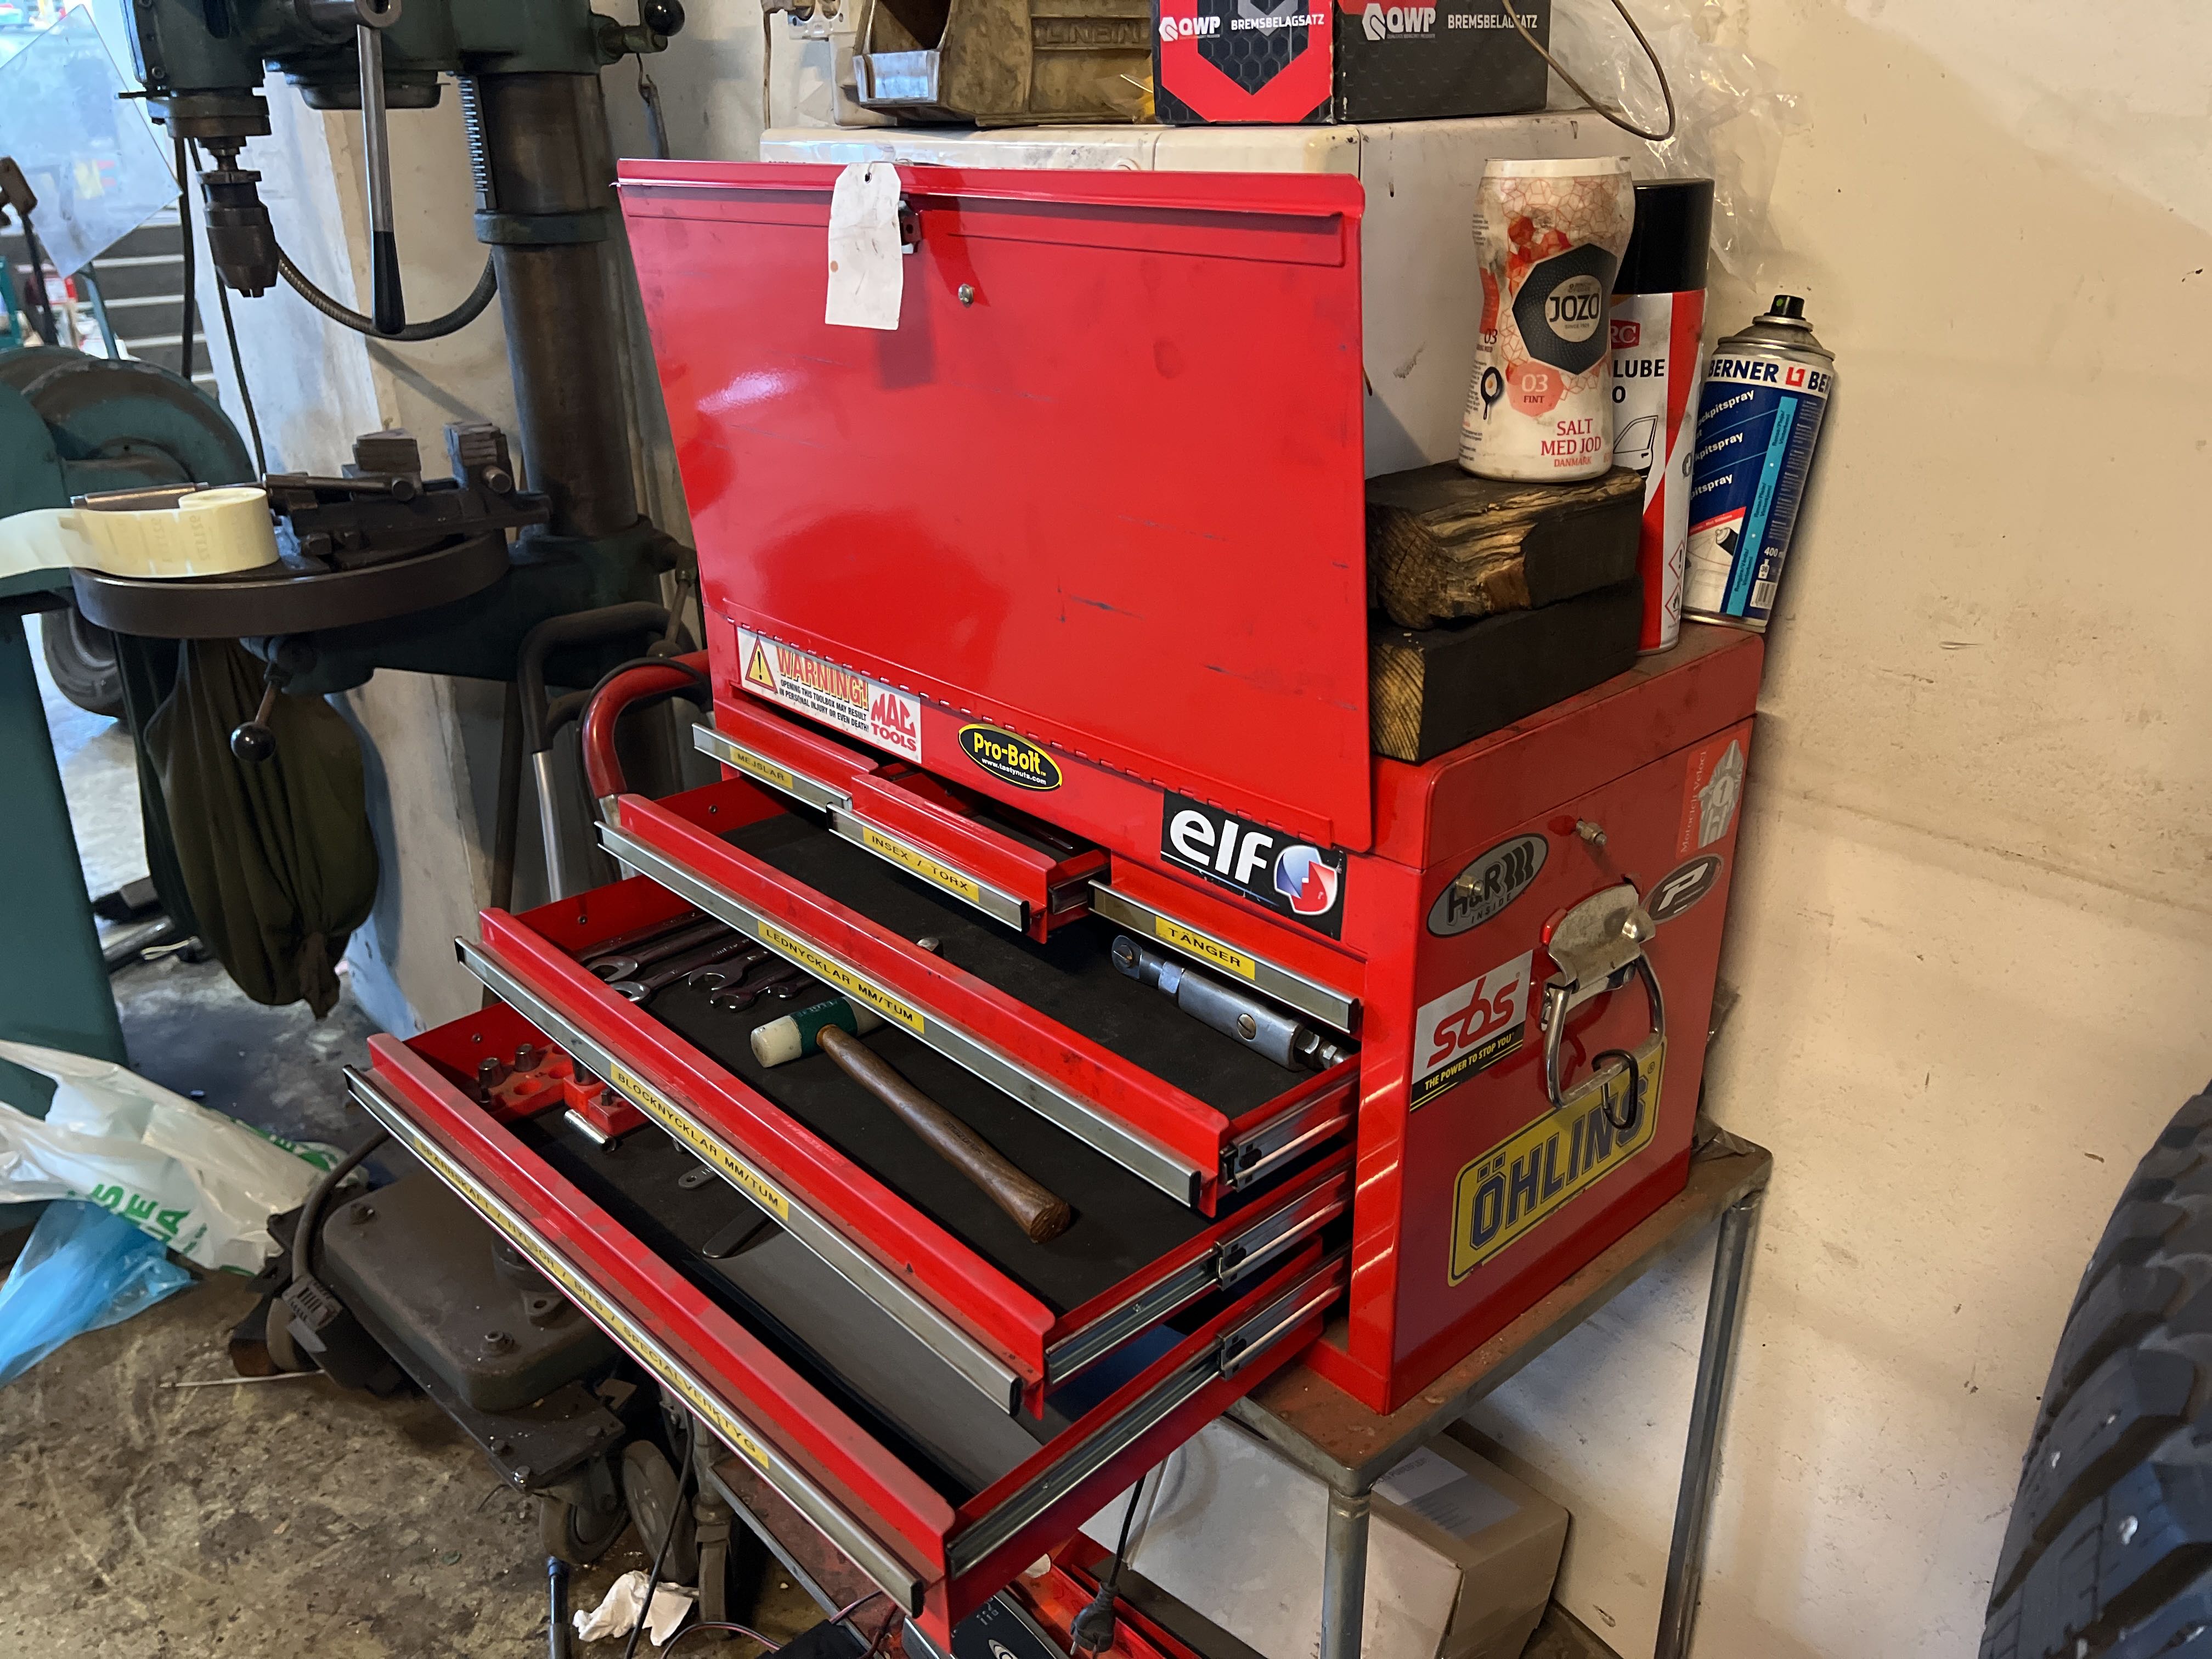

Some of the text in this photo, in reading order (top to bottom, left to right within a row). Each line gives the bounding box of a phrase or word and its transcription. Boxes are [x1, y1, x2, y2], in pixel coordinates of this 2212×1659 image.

[1178, 14, 1325, 36] QWP BREMSBELAGSATZ
[1386, 7, 1538, 33] QWP BREMSBELAGATZ
[1549, 292, 1600, 323] JOZO
[1521, 373, 1549, 393] 03
[1613, 359, 1664, 378] LUBE
[1708, 359, 1779, 383] BERNER
[1523, 395, 1545, 404] FINT
[1556, 417, 1594, 437] SALT
[1541, 436, 1601, 456] MED JOD
[1553, 455, 1592, 467] DANMARK
[1763, 546, 1779, 557] 400
[776, 645, 869, 712] WARNING!
[779, 687, 869, 732] IN PERSONAL INJURY OR EVEN DEATH!
[780, 679, 867, 721] OPENING THIS TOOLBOX MAY RESULT
[871, 722, 917, 752] TOOLS
[737, 753, 785, 782] MEJSLAR
[973, 731, 1041, 775] Pro-Bolt
[981, 758, 1047, 785] www.tastynuts.com
[1170, 809, 1274, 885] elf
[871, 835, 910, 861] INSEX
[932, 867, 969, 892] TORX
[1471, 893, 1511, 924] INSIDE
[766, 928, 850, 985] LEDNYCKLAR
[858, 983, 913, 1022] MM/TUM
[1424, 1076, 1440, 1091] THE
[1440, 1061, 1468, 1084] POWER
[1468, 1054, 1478, 1066] TO
[1478, 1042, 1497, 1060] STOP
[618, 1071, 779, 1207] BLOCKNYCKLAR MM/TUM
[573, 1279, 603, 1311] BITS
